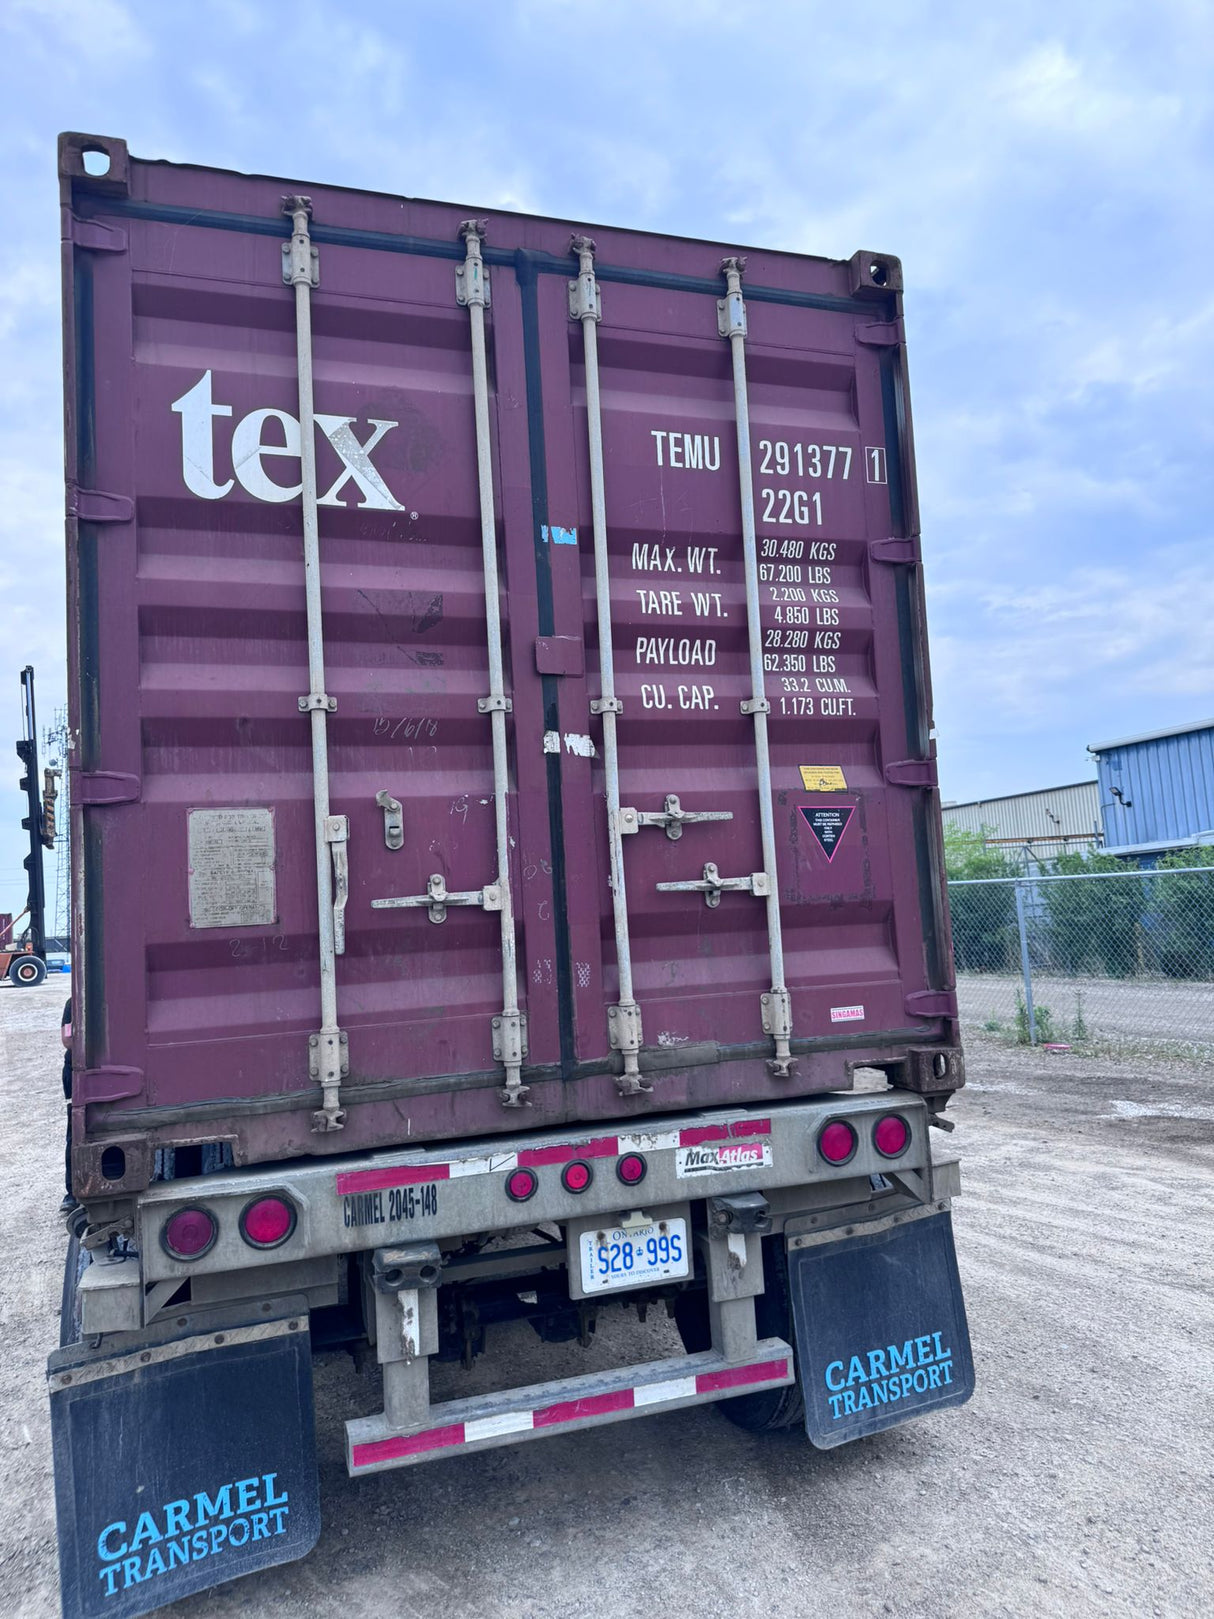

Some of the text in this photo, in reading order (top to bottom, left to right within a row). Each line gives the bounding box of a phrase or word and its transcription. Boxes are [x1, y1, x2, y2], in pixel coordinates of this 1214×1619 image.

[171, 369, 405, 511] tex
[651, 430, 721, 471] TEMU
[758, 440, 852, 480] 291377
[761, 488, 823, 525] 22G1
[631, 543, 722, 575] MAX. WT.
[761, 539, 837, 561] 30.480 KGS
[759, 563, 831, 584] 67.200 LBS
[636, 589, 729, 618] TARE WT.
[769, 586, 839, 603] 2.200 KGS
[774, 605, 840, 625] 4.850 LBS
[635, 636, 717, 666] PAYLOAD
[764, 629, 842, 649] 28.280 KGS
[763, 653, 836, 673] 62.350 LBS
[640, 684, 720, 711] CU. CAP.
[781, 677, 811, 692] 33.2
[780, 696, 814, 715] 1.173
[831, 1009, 864, 1020] SINGAMAS
[343, 1183, 438, 1228] CARMEL 2045-148
[612, 1226, 655, 1241] ONARIO
[597, 1234, 682, 1275] S28 99S
[825, 1331, 951, 1391] CARMEL
[828, 1361, 953, 1420] TRANSPORT
[97, 1472, 288, 1562] CARMEL
[99, 1506, 289, 1597] TRANSPORT
